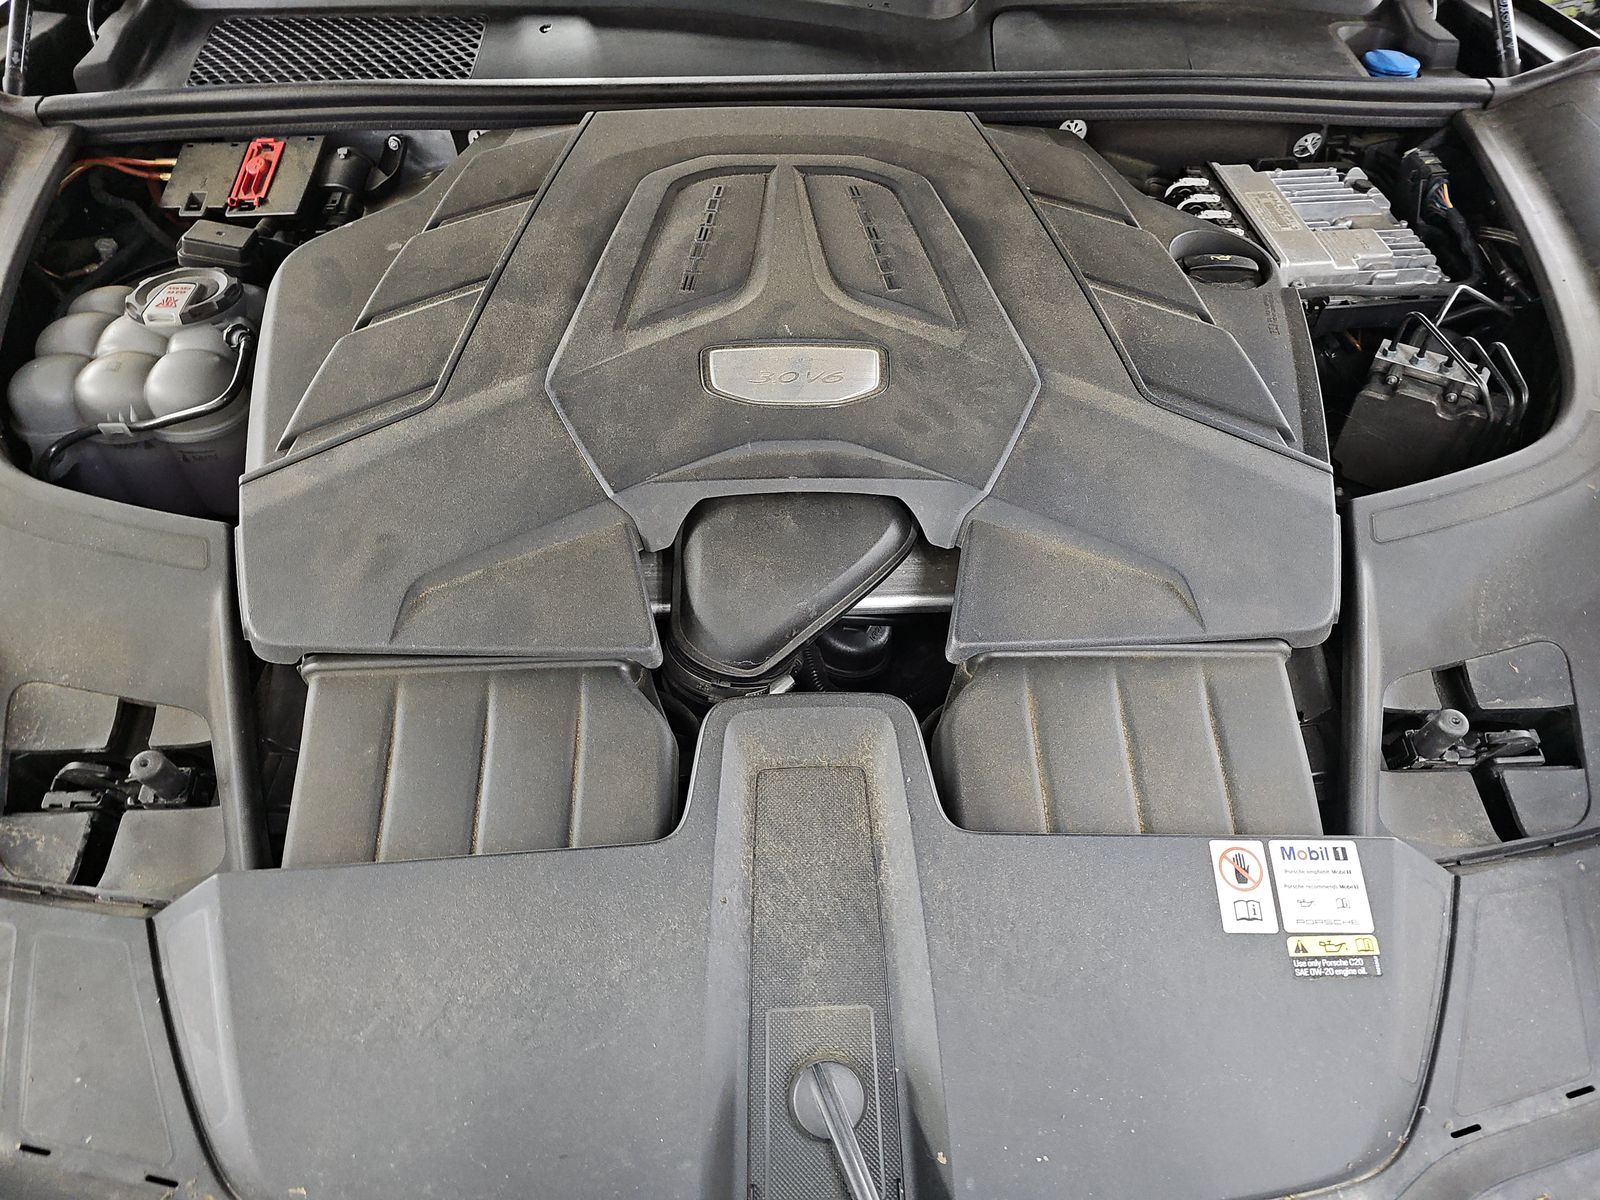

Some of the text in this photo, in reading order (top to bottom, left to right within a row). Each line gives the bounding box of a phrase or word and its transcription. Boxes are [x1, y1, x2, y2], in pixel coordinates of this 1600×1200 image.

[1280, 846, 1348, 861] Mobil 1
[1293, 959, 1307, 967] Use
[1307, 959, 1321, 968] only
[1322, 958, 1348, 967] Porsche
[1348, 958, 1364, 966] C20
[1294, 968, 1310, 976] SAE
[1309, 967, 1335, 976] 0W-20
[1334, 967, 1357, 977] engine
